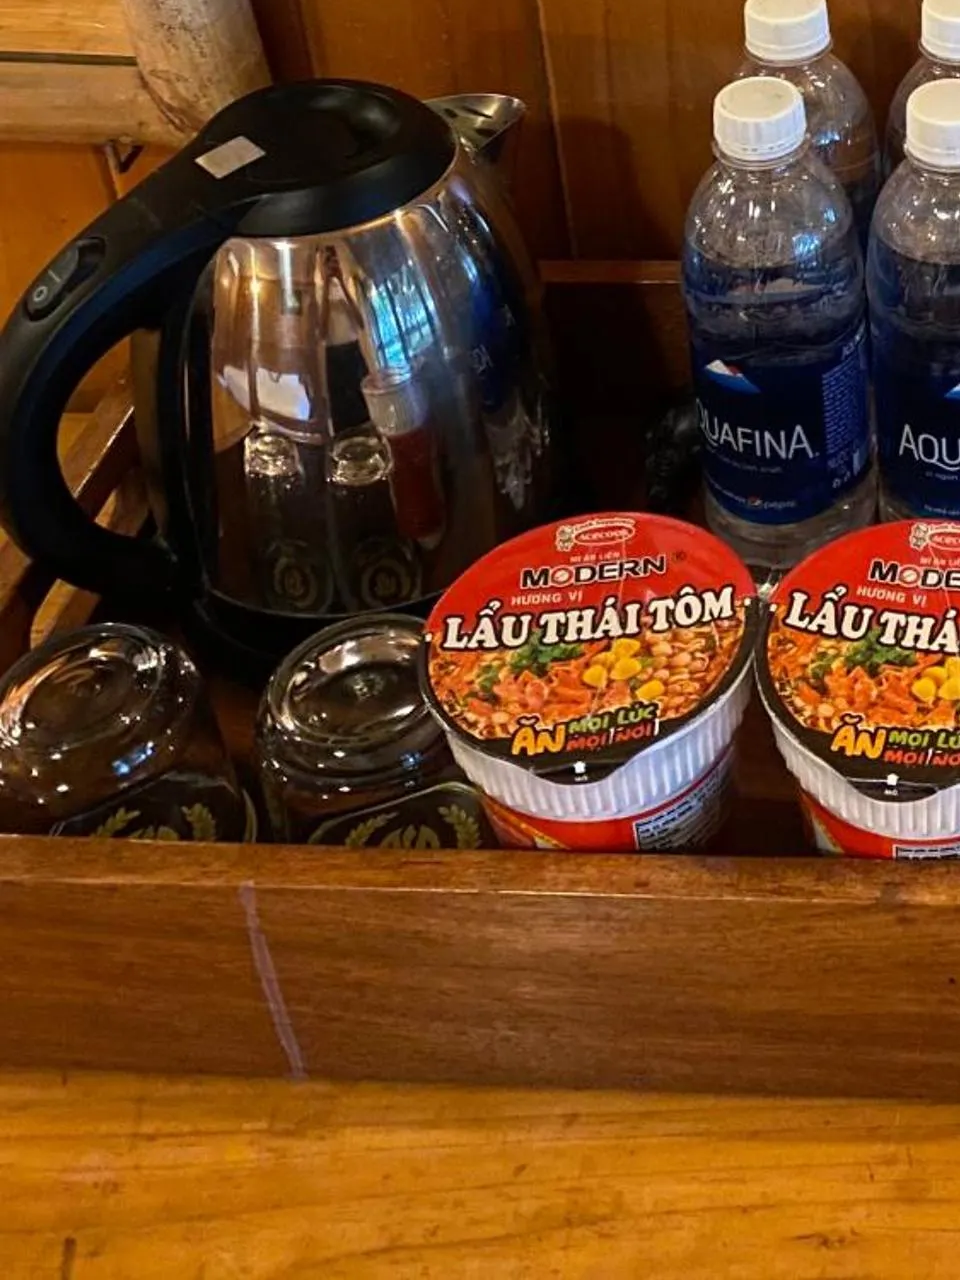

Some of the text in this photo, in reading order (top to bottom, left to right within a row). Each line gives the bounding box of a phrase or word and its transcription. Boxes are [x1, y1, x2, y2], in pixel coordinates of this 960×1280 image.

[696, 397, 814, 460] QUAFINA
[520, 554, 667, 589] MODERN
[442, 585, 734, 650] LẨU THÁI TÔM
[568, 589, 583, 606] VỊ
[784, 585, 875, 639] LẨU
[912, 594, 928, 610] VỊ
[511, 716, 566, 756] ĂN
[830, 714, 887, 759] ĂN
